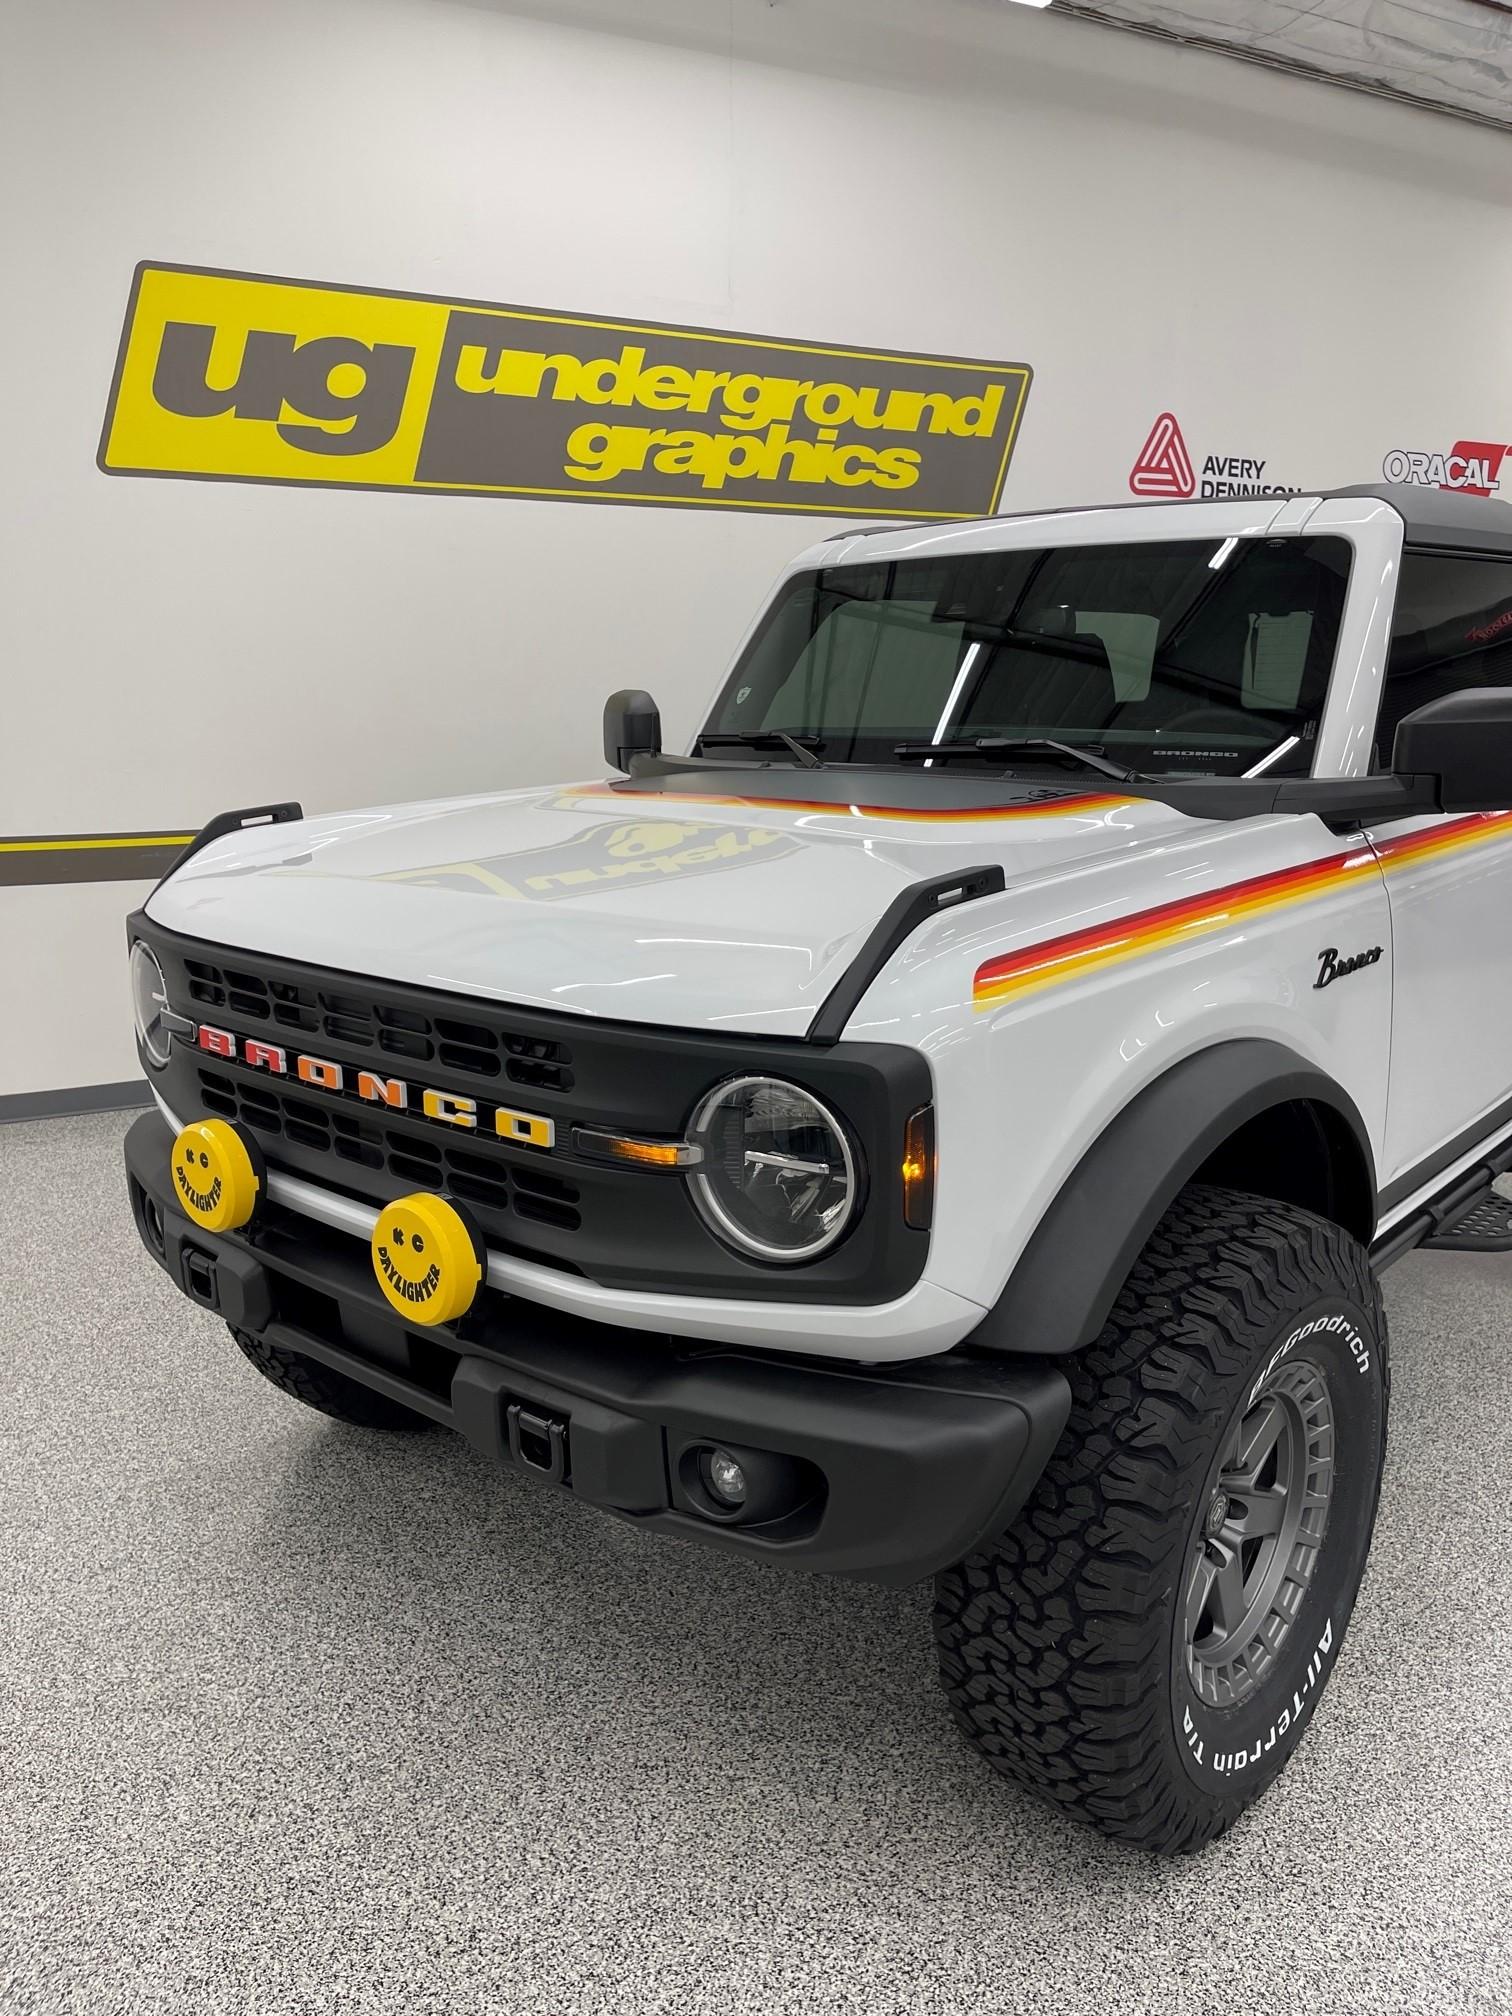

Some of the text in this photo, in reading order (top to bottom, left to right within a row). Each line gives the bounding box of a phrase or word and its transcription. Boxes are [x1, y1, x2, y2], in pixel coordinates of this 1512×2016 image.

[153, 321, 415, 458] ug
[454, 343, 1005, 439] underground
[564, 421, 921, 489] graphics
[1202, 455, 1267, 480] AVERY
[1383, 449, 1501, 490] ORACAL
[1201, 480, 1302, 499] DENNI
[1312, 946, 1385, 990] Bronco
[199, 1024, 556, 1149] BRONCO
[175, 1166, 223, 1213] DAYLIGHTER
[377, 1246, 441, 1303] DAYLIGHTER
[1213, 1617, 1334, 1777] All-Terrain
